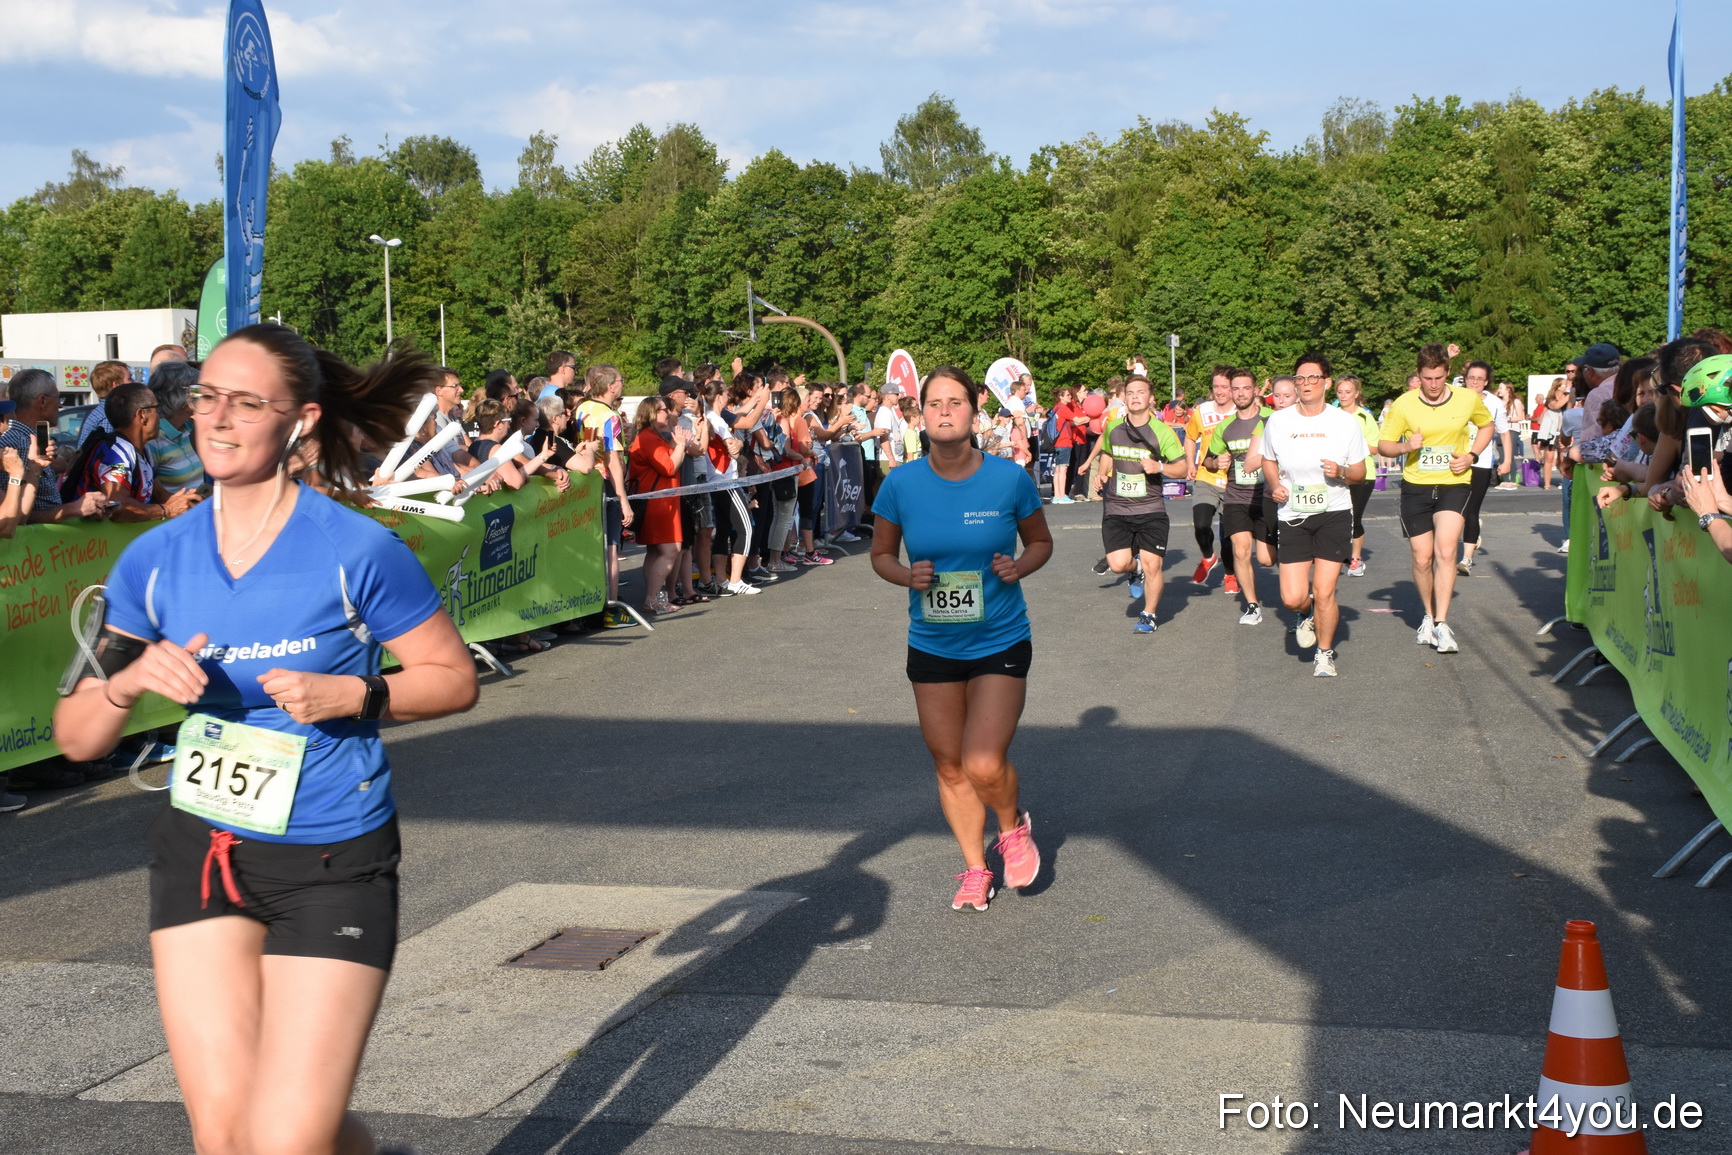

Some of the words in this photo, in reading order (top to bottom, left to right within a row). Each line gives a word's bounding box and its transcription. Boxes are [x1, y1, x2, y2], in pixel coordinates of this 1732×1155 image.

[1111, 445, 1152, 460] BOCK
[1421, 454, 1450, 465] 2193
[1121, 481, 1138, 491] 297
[1295, 493, 1324, 505] 1166
[969, 510, 1000, 518] PFLEIDERER
[48, 538, 109, 574] Firmen
[466, 543, 539, 604] firmenlauf
[468, 596, 501, 619] neumarkt
[926, 589, 975, 609] 1854
[6, 587, 62, 632] laufen
[186, 750, 278, 801] 2157
